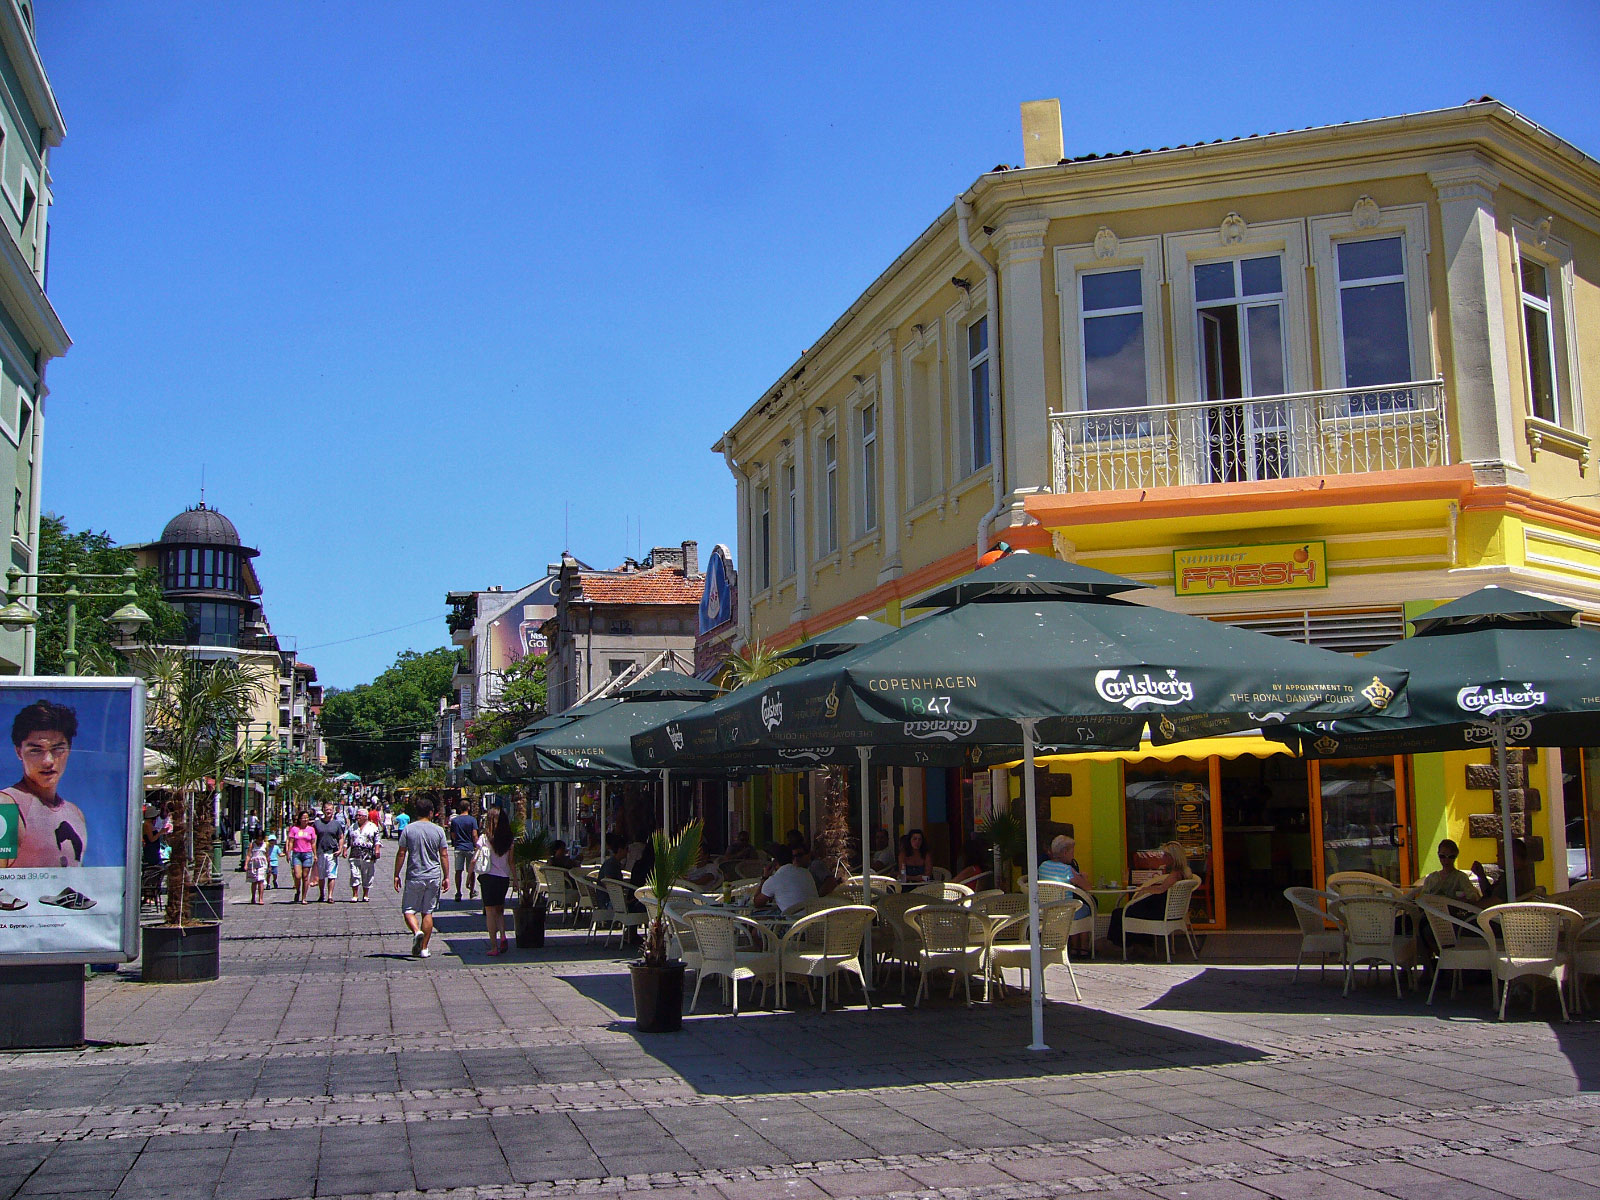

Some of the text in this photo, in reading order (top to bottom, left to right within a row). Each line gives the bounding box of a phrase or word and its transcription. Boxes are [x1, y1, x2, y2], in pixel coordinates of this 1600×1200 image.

[1180, 552, 1248, 564] summer
[1182, 560, 1316, 590] FRESH
[868, 676, 978, 692] COPENHAGEN
[1094, 669, 1194, 710] Carlsberg
[1285, 684, 1341, 692] APPOINTMENT
[1343, 685, 1354, 693] TO
[900, 696, 952, 715] 1847
[1229, 694, 1356, 704] THE ROYAL DANISH COURT
[1456, 682, 1547, 716] Carlsberg
[1581, 696, 1600, 704] THE
